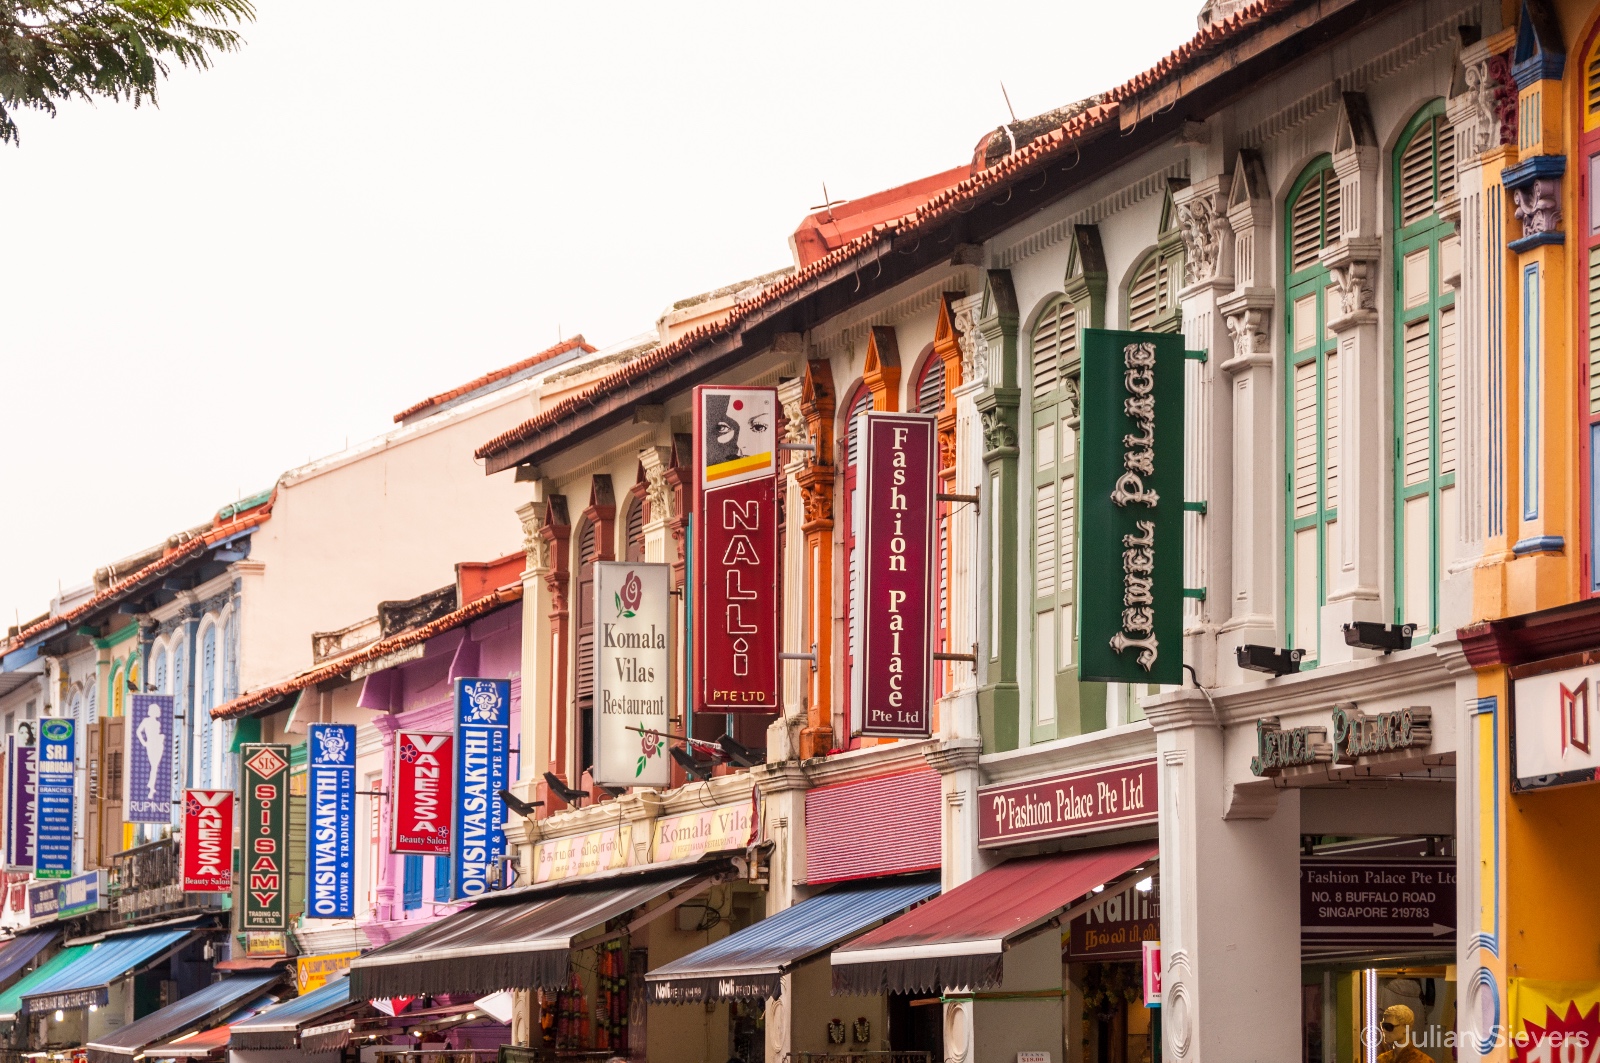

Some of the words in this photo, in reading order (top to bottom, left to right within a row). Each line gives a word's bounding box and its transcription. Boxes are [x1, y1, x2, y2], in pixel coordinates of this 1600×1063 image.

[889, 427, 909, 572] Fashion
[603, 622, 666, 649] Komala
[888, 589, 906, 707] Palace
[615, 657, 655, 683] Vilas
[602, 689, 665, 716] Restaurant
[713, 690, 738, 701] PTE
[741, 691, 765, 702] LTD
[871, 709, 893, 723] Pte
[897, 710, 919, 725] Ltd
[493, 730, 503, 752] LTD
[46, 744, 67, 760] SRI
[39, 760, 73, 773] MURUGAN
[257, 757, 276, 770] SIS
[493, 756, 502, 777] PTE
[341, 770, 350, 788] LTD
[406, 735, 450, 833] VANESSA
[341, 792, 349, 810] PTE
[492, 780, 502, 832] TRADING
[1007, 793, 1053, 829] Fashion
[1055, 785, 1094, 822] Palace
[1096, 781, 1118, 815] Pte
[1121, 773, 1144, 811] Ltd
[463, 730, 489, 896] OMSIVASAKTHI
[190, 791, 231, 876] VANESSA
[341, 819, 349, 858] TRADING
[400, 835, 425, 845] Beauty
[427, 836, 447, 845] Salon
[492, 835, 500, 843] &
[660, 817, 712, 844] Komala
[315, 770, 337, 915] OMSIVASAKTHI
[185, 876, 209, 886] Beauty
[210, 877, 230, 885] Salon
[1307, 870, 1360, 884] Fashion
[1364, 870, 1406, 884] Palace
[1411, 871, 1433, 884] Pte
[340, 872, 349, 912] FLOWER
[1311, 891, 1332, 902] NO.
[1335, 891, 1343, 902] 8
[1345, 891, 1399, 903] BUFFALO
[1402, 892, 1436, 903] ROAD
[1318, 907, 1388, 918] SINGAPORE
[1391, 907, 1430, 918] 219783
[718, 979, 735, 997] Nalli
